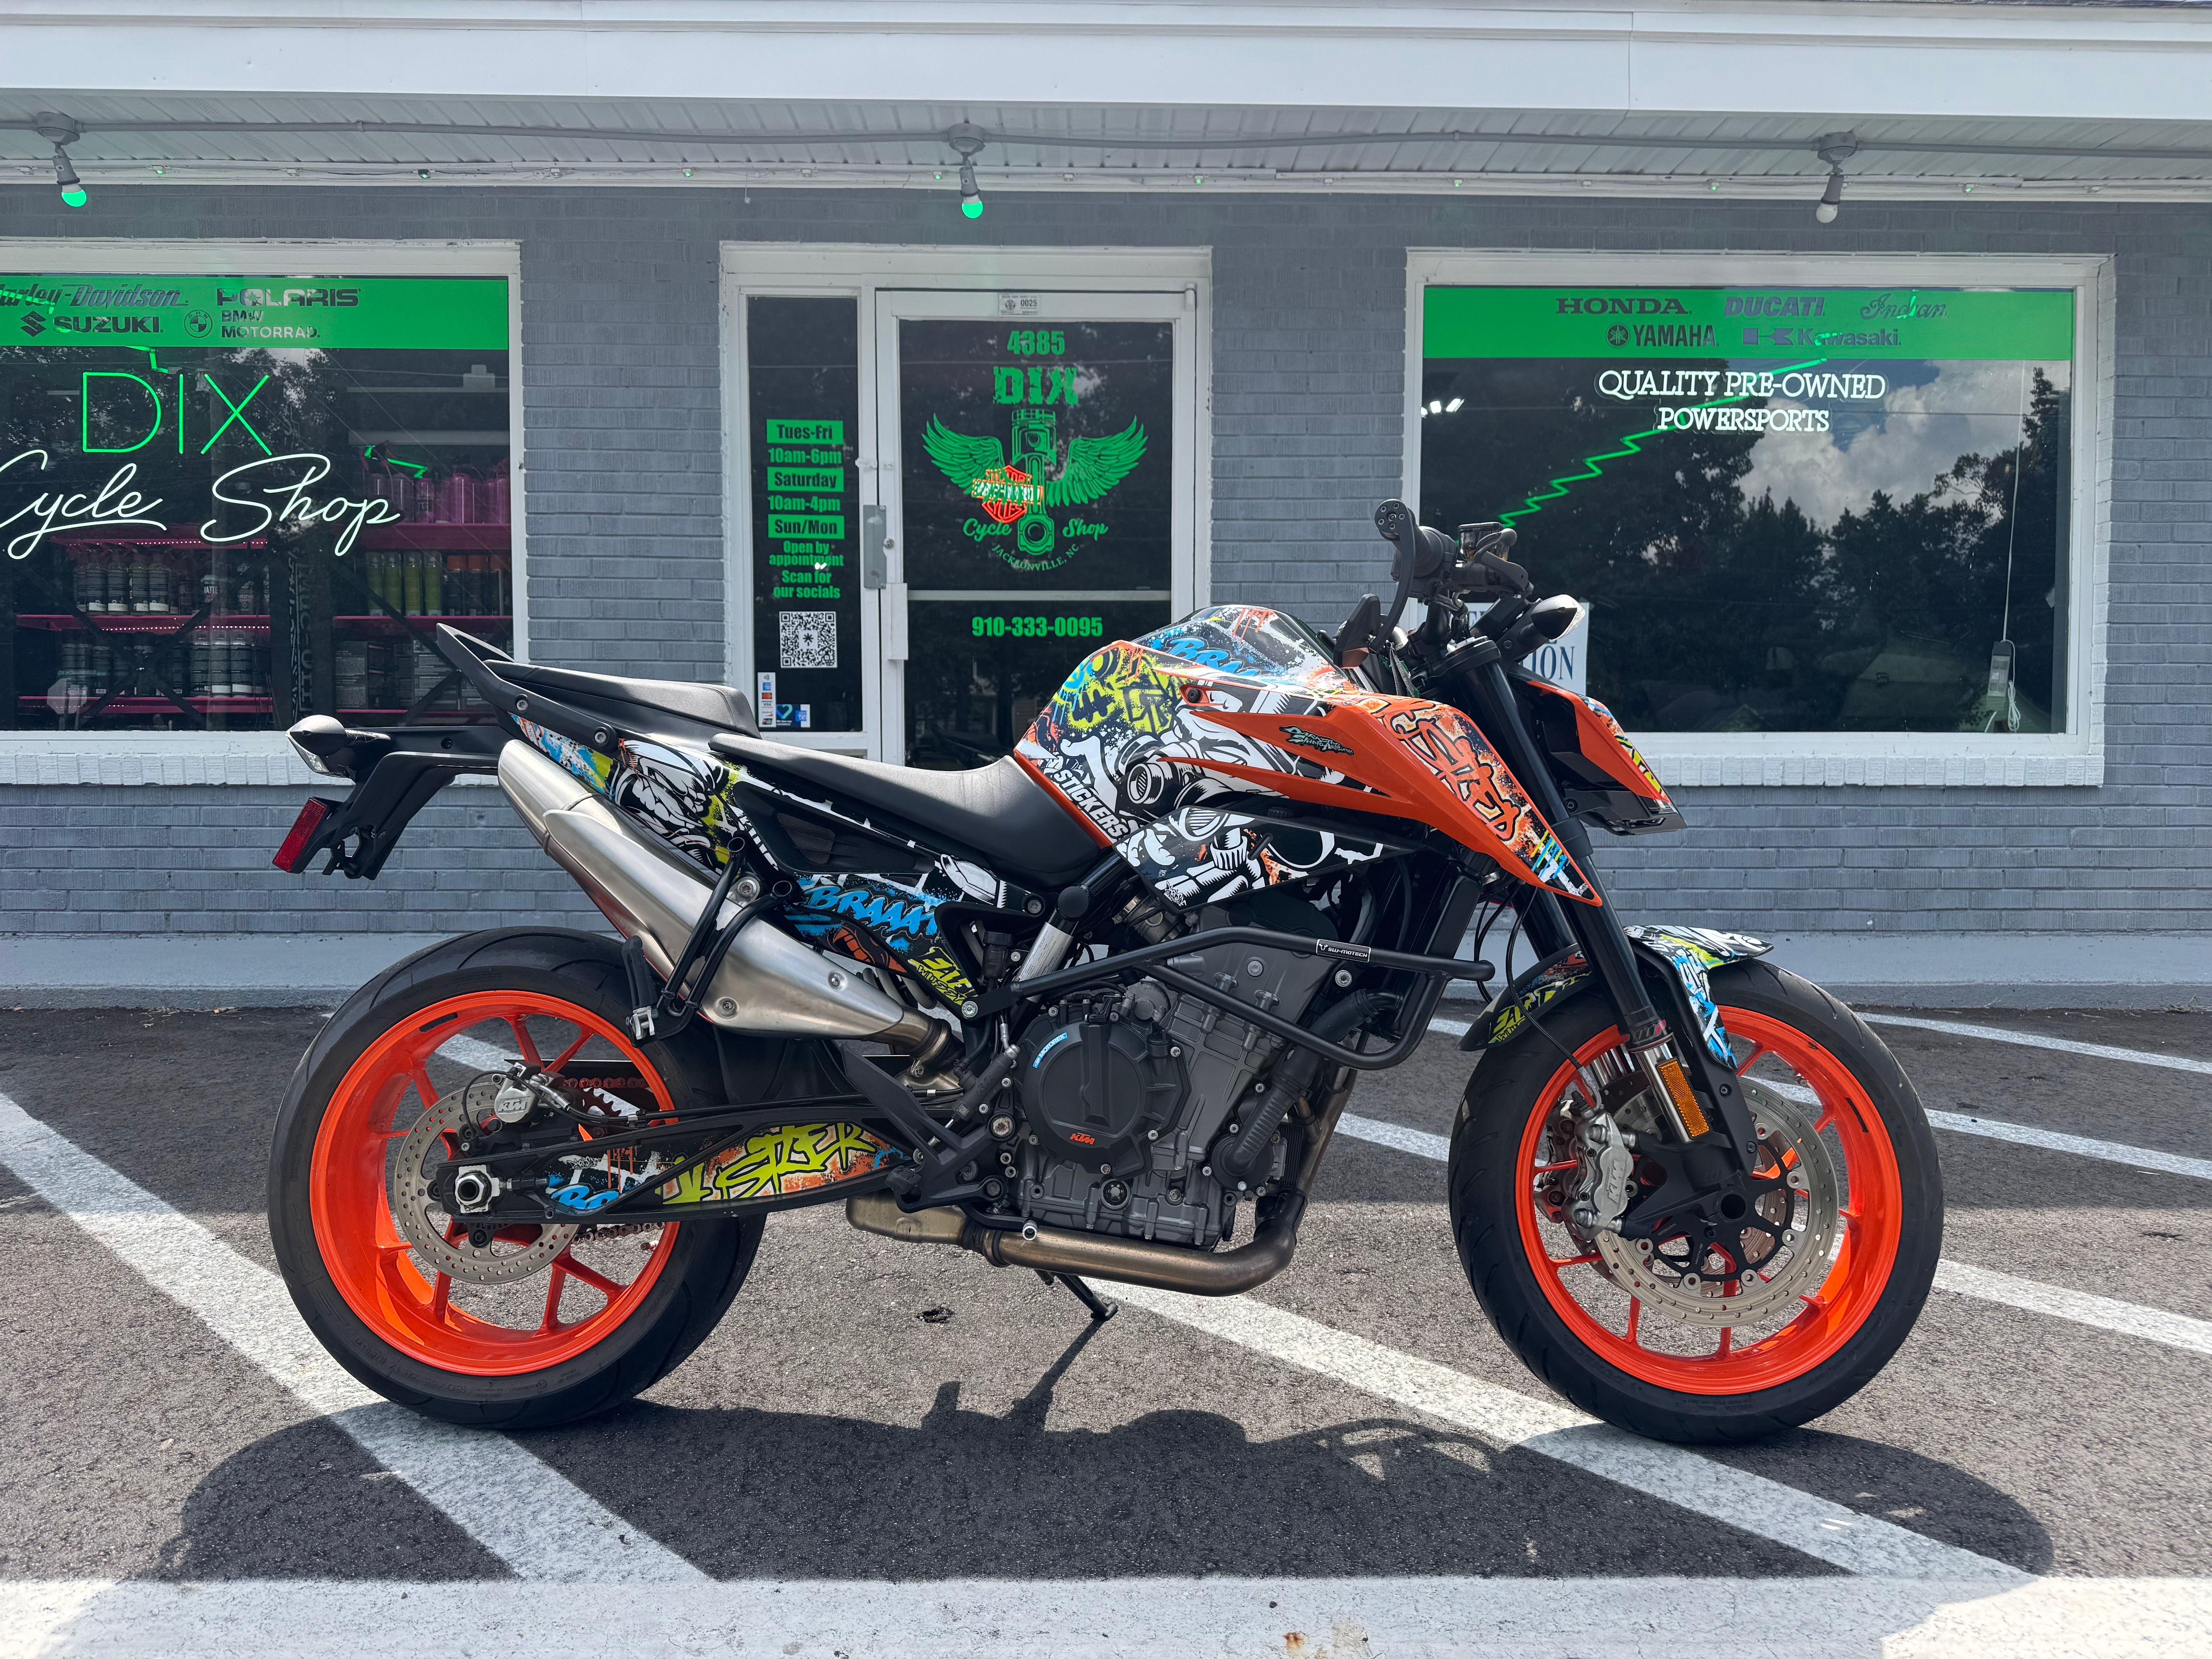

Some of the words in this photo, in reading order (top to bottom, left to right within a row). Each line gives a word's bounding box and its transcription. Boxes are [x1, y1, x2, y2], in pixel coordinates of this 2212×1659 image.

[217, 288, 359, 306] POLARIS
[1556, 298, 1688, 314] HONDA
[1723, 297, 1825, 316] DUCATI
[1860, 294, 1948, 320] Indian
[53, 316, 160, 333] SUZUKI
[222, 310, 264, 322] BMW
[222, 326, 318, 338] MOTORRAD
[1633, 325, 1716, 347] YAMAHA
[1798, 328, 1899, 346] Kawasaki
[1007, 330, 1065, 355] 4385
[993, 366, 1079, 405] DIX
[1598, 370, 1719, 401] QUALITY
[1724, 371, 1886, 400] PRE-OWNED
[82, 371, 272, 456] DIX
[1657, 407, 1830, 433] POWERSPORTS
[776, 424, 833, 440] Tues-Fri
[768, 448, 842, 465] 10am-6pm
[774, 472, 837, 488] Saturday
[0, 449, 167, 559] Cycle
[200, 453, 400, 556] Shop
[768, 495, 841, 512] 10am-4pm
[775, 519, 838, 534] Sun/Mon
[963, 518, 1012, 542] Cycle
[1062, 519, 1108, 541] Shop
[783, 541, 813, 554] Open
[816, 541, 830, 555] by
[1066, 544, 1079, 558] NC
[769, 554, 844, 567] appointment
[781, 570, 812, 583] Scan
[814, 570, 831, 584] for
[773, 586, 794, 598] our
[796, 585, 840, 599] socials
[972, 616, 1103, 637] 910-333-0095
[1053, 769, 1129, 837] STICKERS
[1328, 947, 1368, 958] SW-MOTECH
[1038, 1033, 1065, 1058] MOTOREX
[497, 1099, 527, 1112] KTM
[1069, 1132, 1095, 1145] KTM
[1606, 1159, 1623, 1204] KTM
